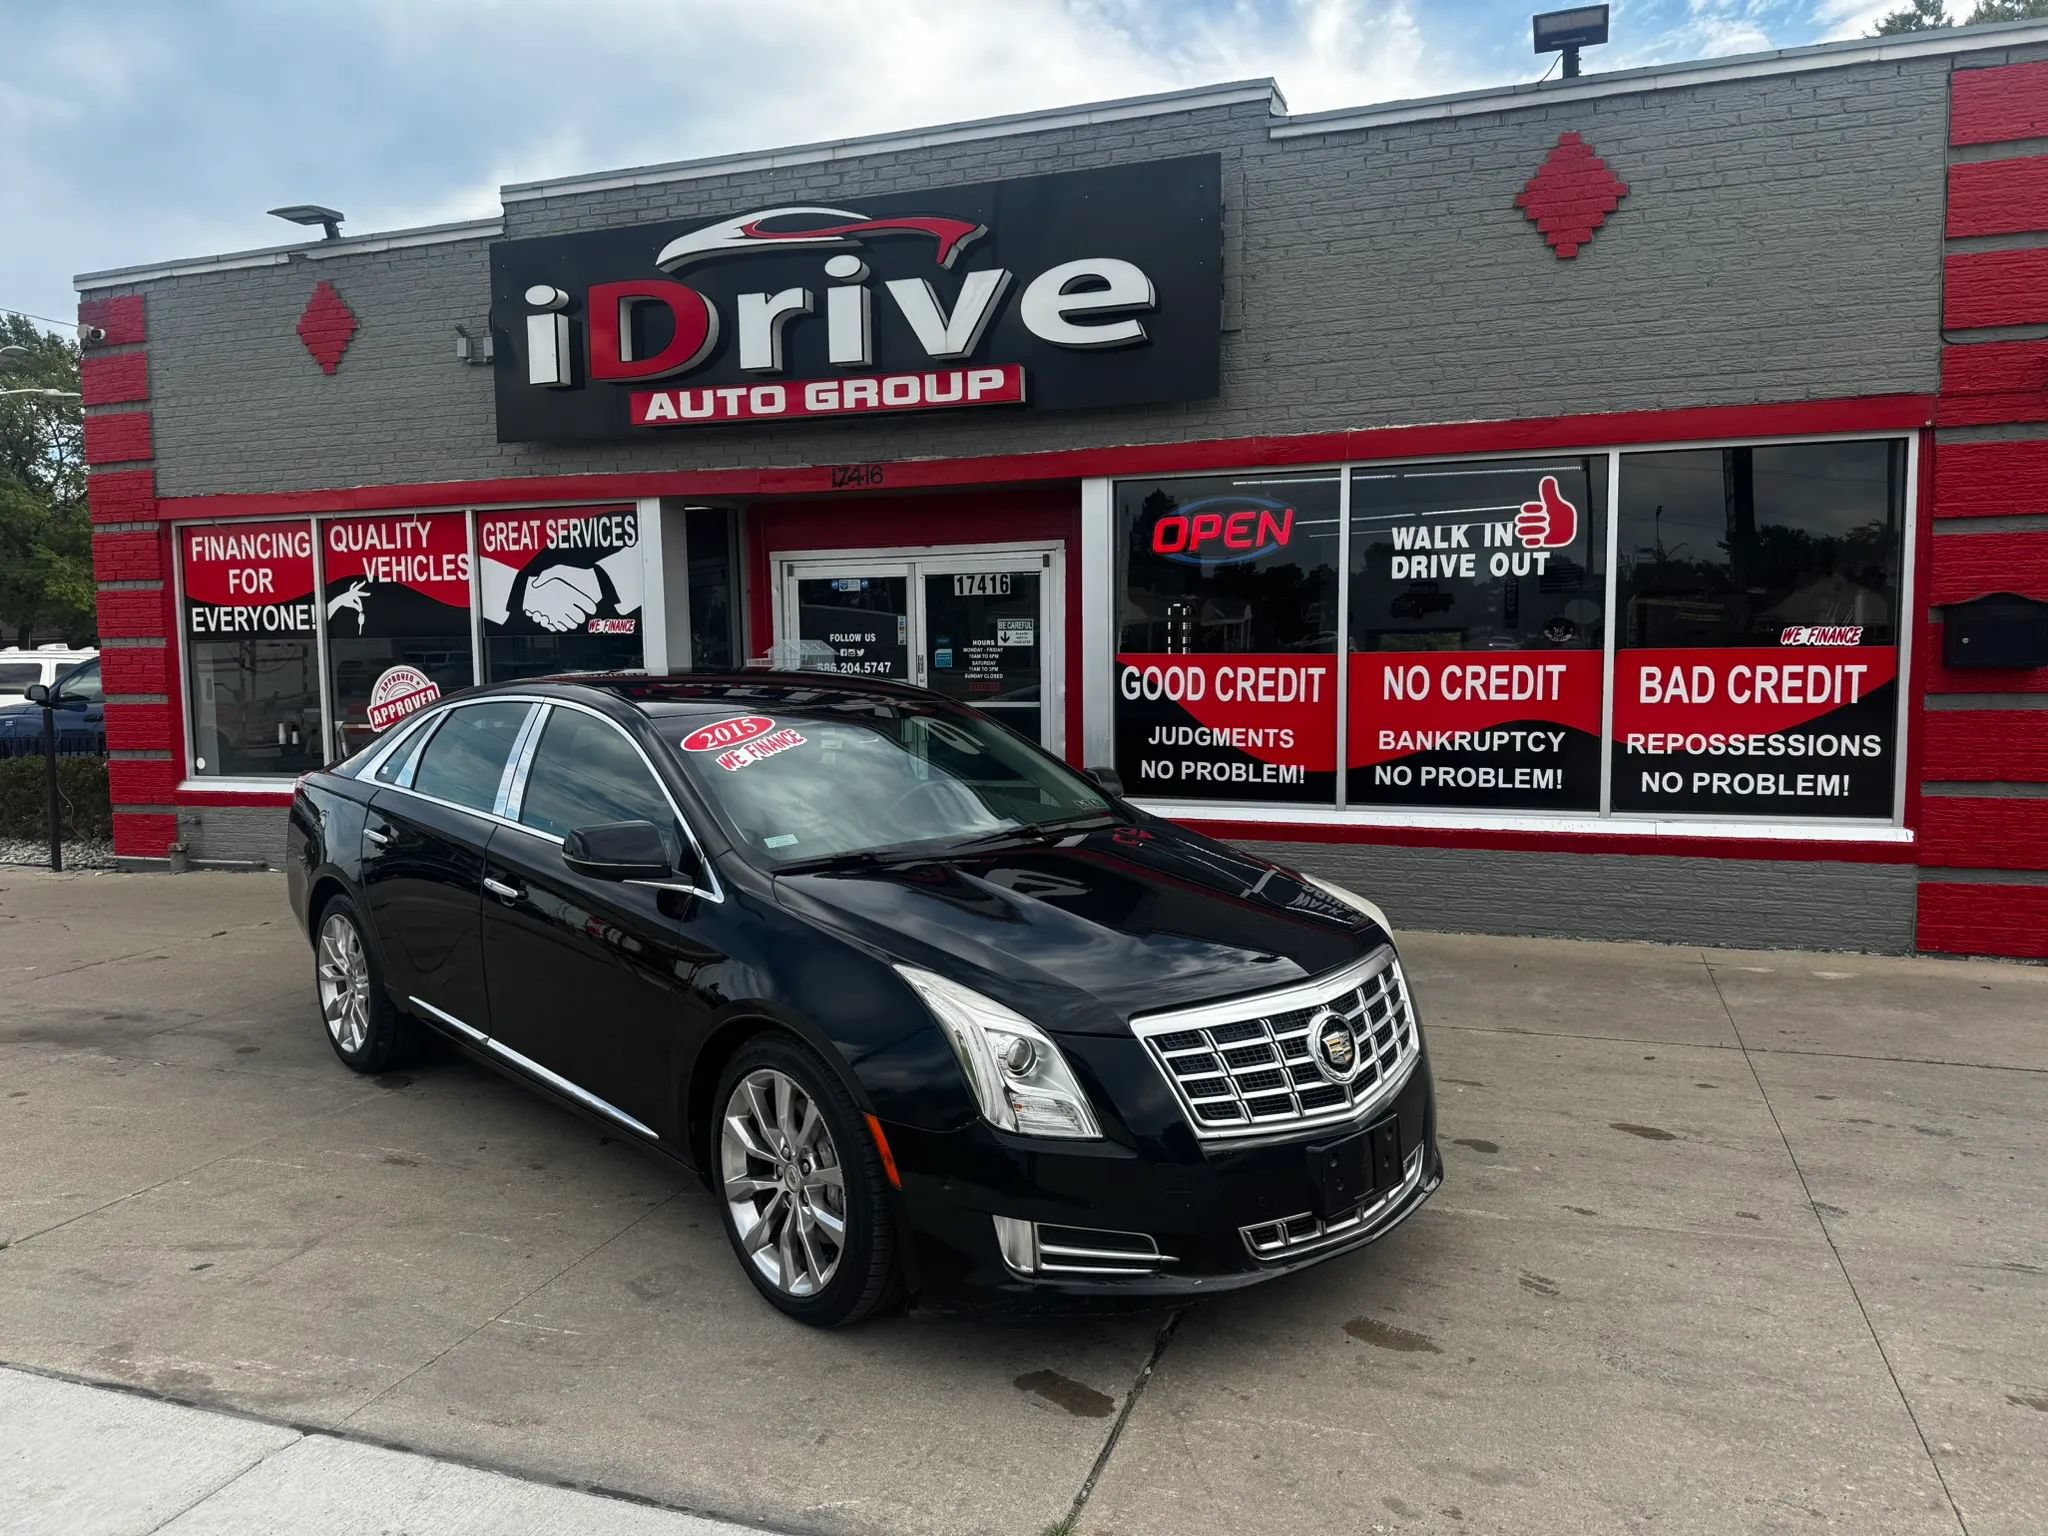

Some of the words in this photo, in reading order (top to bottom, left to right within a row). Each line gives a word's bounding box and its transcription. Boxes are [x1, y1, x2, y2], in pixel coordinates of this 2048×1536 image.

[525, 254, 1156, 388] iDrive
[643, 385, 787, 422] AUTO
[805, 369, 1006, 412] GROUP
[831, 464, 883, 488] 17416
[329, 521, 431, 552] QUALITY
[483, 520, 541, 552] GREAT
[546, 515, 636, 549] SERVICES
[1152, 508, 1294, 554] OPEN
[1391, 525, 1470, 551] WALK
[1484, 522, 1514, 548] IN
[191, 531, 311, 562] FINANCING
[362, 554, 470, 583] VEHICLES
[1391, 553, 1476, 580] DRIVE
[1489, 551, 1551, 578] OUT
[228, 567, 274, 594] FOR
[956, 574, 1009, 595] 17416
[191, 604, 316, 632] EVERYONE!
[589, 619, 602, 632] WE
[603, 619, 635, 632] FINANCE
[998, 621, 1007, 630] BE
[1007, 621, 1032, 630] CAREFUL
[829, 633, 862, 642] FOLLOW
[864, 633, 877, 642] US
[1781, 627, 1804, 644] WE
[1807, 626, 1863, 645] FINANCE
[381, 673, 414, 692] APPROVED
[1120, 666, 1206, 701] GOOD
[1215, 667, 1326, 702] CREDIT
[1383, 665, 1431, 701] NO
[1441, 664, 1567, 701] CREDIT
[1639, 665, 1715, 704] BAD
[1727, 664, 1867, 704] CREDIT
[373, 689, 436, 725] APPROVED
[699, 718, 758, 748] 2015
[1148, 726, 1295, 748] JUDGMENTS
[1378, 730, 1566, 752] BANKRUPTCY
[1626, 733, 1881, 757] REPOSSESSIONS
[720, 751, 747, 769] WE
[744, 729, 804, 760] FINANCE
[1141, 760, 1174, 779] NO
[1182, 761, 1305, 784] PROBLEM!
[1374, 765, 1412, 786] NO
[1420, 766, 1563, 790] PROBLEM!
[1641, 771, 1683, 793] NO
[1692, 772, 1850, 796] PROBLEM!
